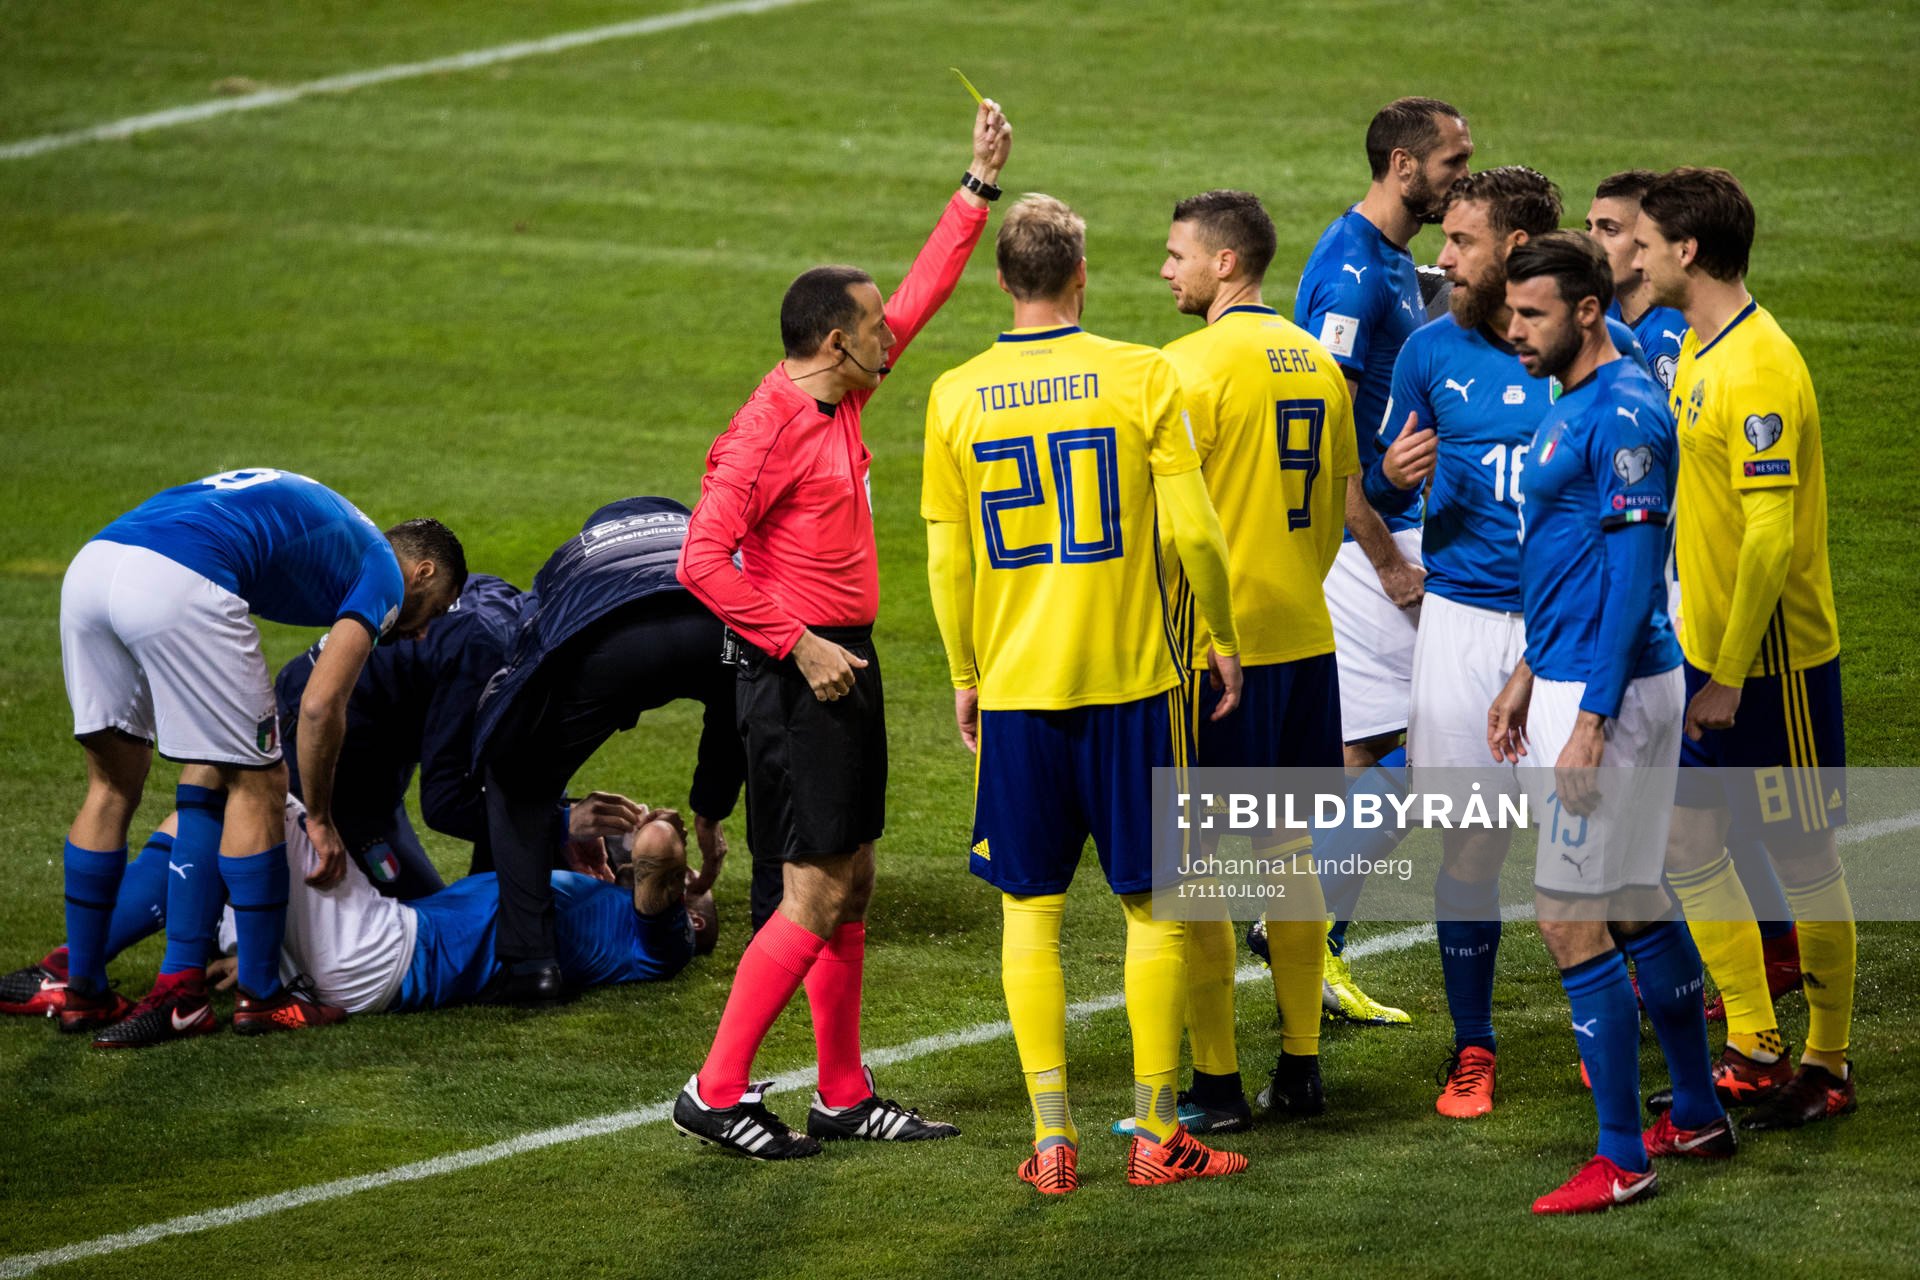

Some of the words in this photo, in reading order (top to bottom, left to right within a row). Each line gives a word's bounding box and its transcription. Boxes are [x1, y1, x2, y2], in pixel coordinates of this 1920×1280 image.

[1266, 348, 1318, 374] BERG
[976, 372, 1100, 413] TOIVONEN
[1276, 398, 1326, 532] 9
[972, 426, 1125, 570] 20
[1754, 764, 1793, 824] 8
